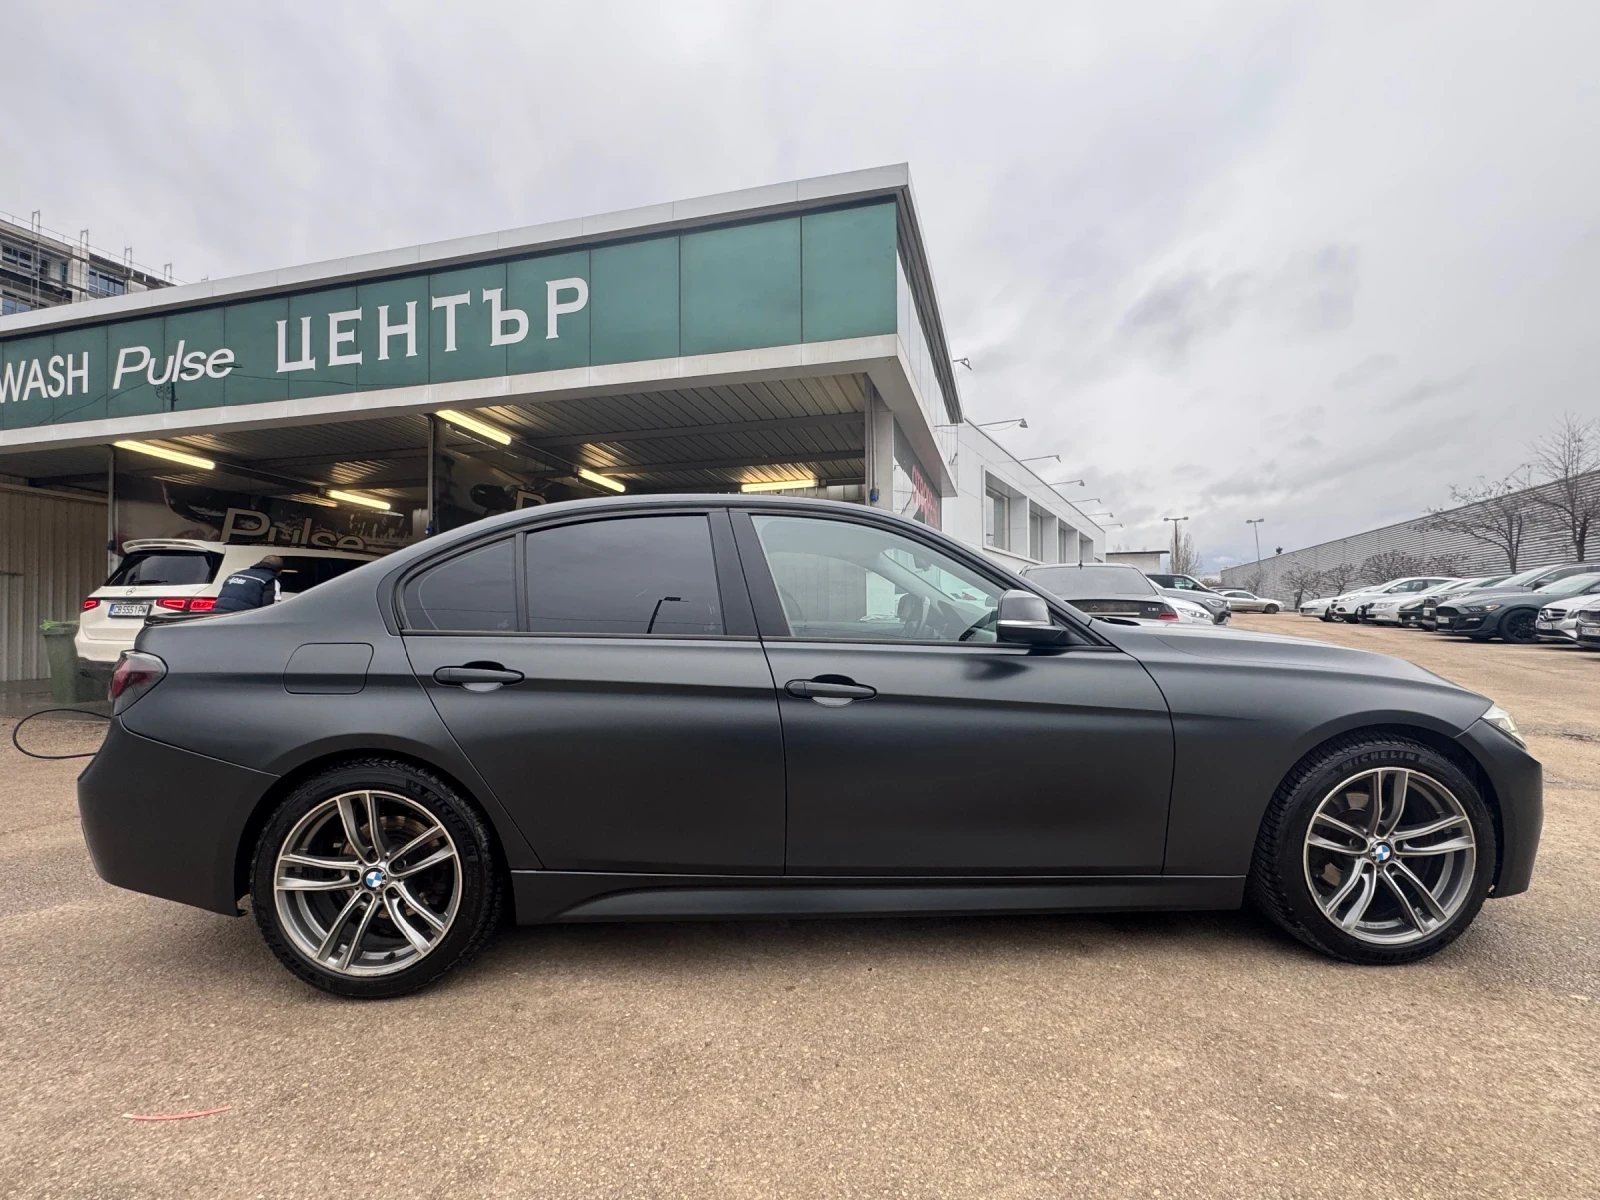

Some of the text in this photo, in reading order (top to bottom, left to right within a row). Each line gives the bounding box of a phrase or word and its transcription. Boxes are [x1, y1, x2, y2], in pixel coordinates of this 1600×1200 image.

[276, 277, 589, 373] ЦЕНТЪР
[0, 340, 235, 404] WASH Pulse
[1340, 750, 1416, 771] MICHELIN
